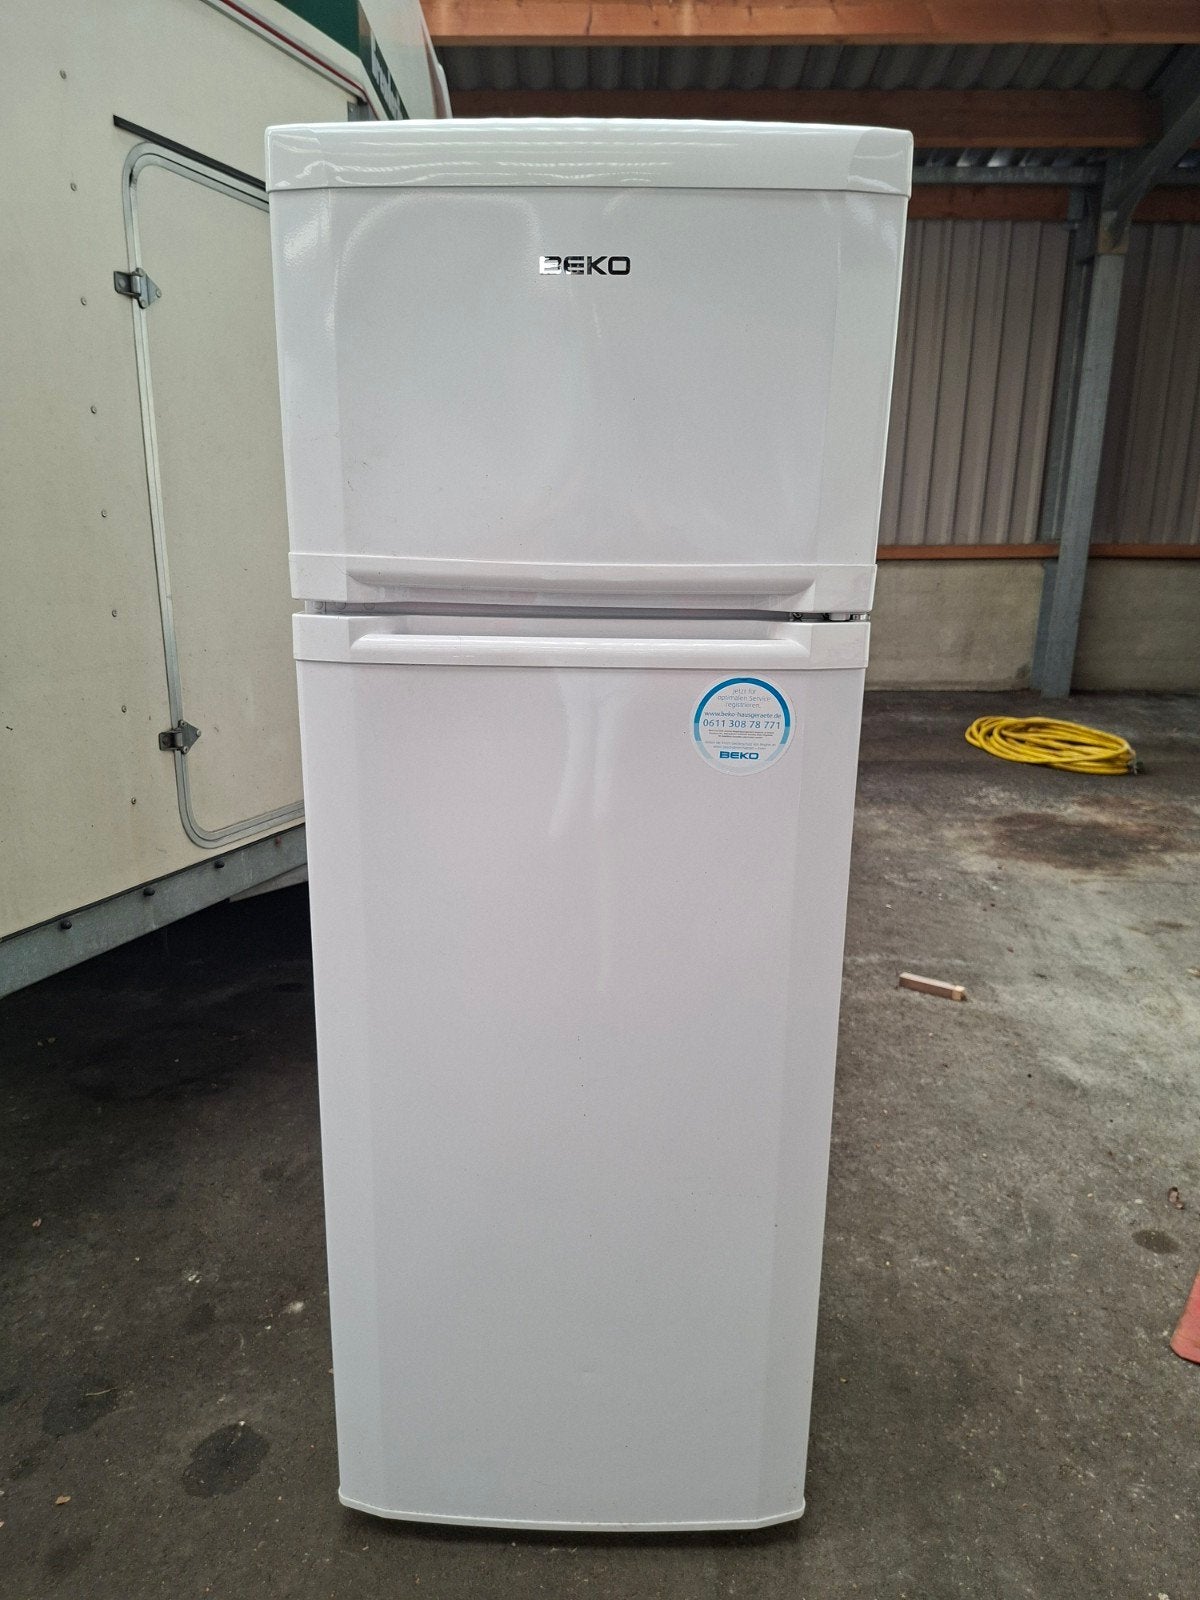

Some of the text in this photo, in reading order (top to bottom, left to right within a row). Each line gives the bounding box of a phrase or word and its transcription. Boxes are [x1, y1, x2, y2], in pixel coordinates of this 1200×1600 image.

[539, 255, 631, 275] BEKO
[703, 719, 780, 730] 0611 308 78 771
[720, 751, 759, 760] BEKO
